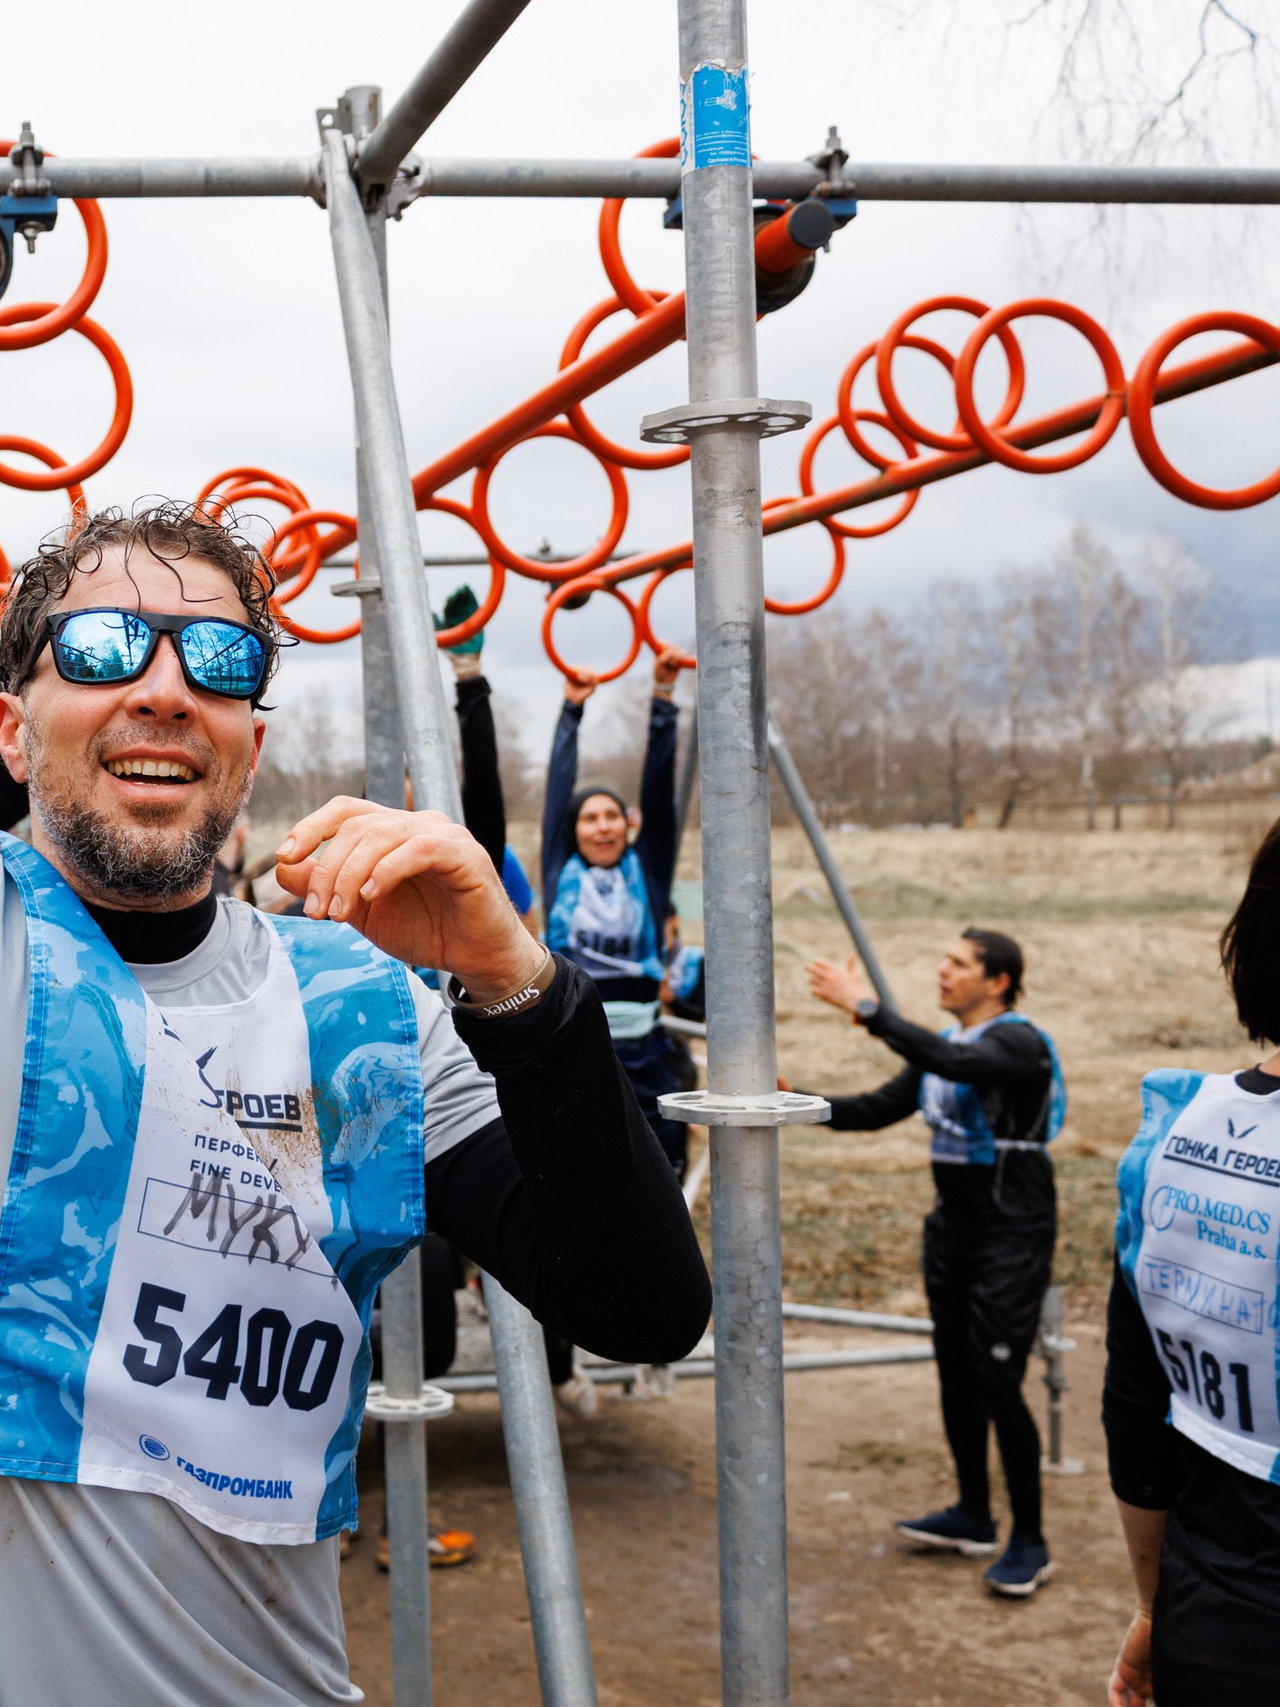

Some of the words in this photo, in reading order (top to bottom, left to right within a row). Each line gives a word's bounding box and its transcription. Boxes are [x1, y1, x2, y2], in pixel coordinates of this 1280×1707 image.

[483, 983, 540, 1016] Sminex
[190, 1159, 232, 1180] FINE
[1165, 1135, 1218, 1163] ГОНКА
[1164, 1185, 1271, 1234] PRO.MED.CS
[1196, 1219, 1236, 1251] Praha
[1239, 1240, 1252, 1256] a.
[1253, 1244, 1267, 1260] s.
[122, 1281, 345, 1412] 5400
[1156, 1328, 1254, 1433] 5181
[176, 1456, 293, 1499] ГАЗПРОМБАНК
